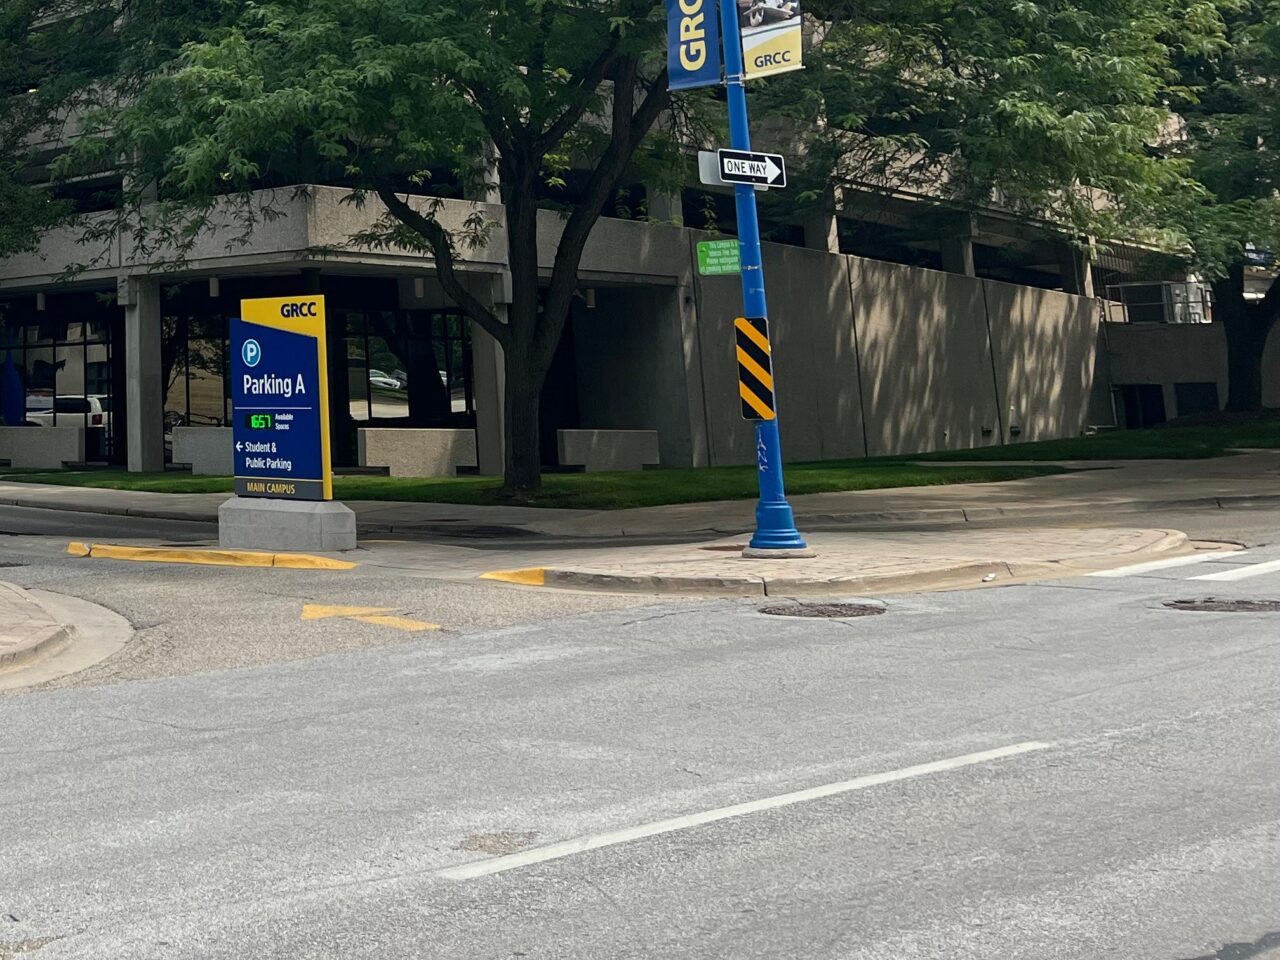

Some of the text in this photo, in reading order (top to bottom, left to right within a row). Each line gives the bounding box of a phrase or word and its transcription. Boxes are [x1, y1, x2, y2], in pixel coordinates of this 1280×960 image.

[754, 50, 791, 68] GRCC
[726, 160, 767, 175] ONE WAY
[280, 302, 317, 318] GRCC
[243, 373, 306, 397] Parking A
[245, 441, 277, 453] Student &
[245, 457, 292, 471] Public Parking
[247, 482, 295, 495] MAIN CAMPUS
